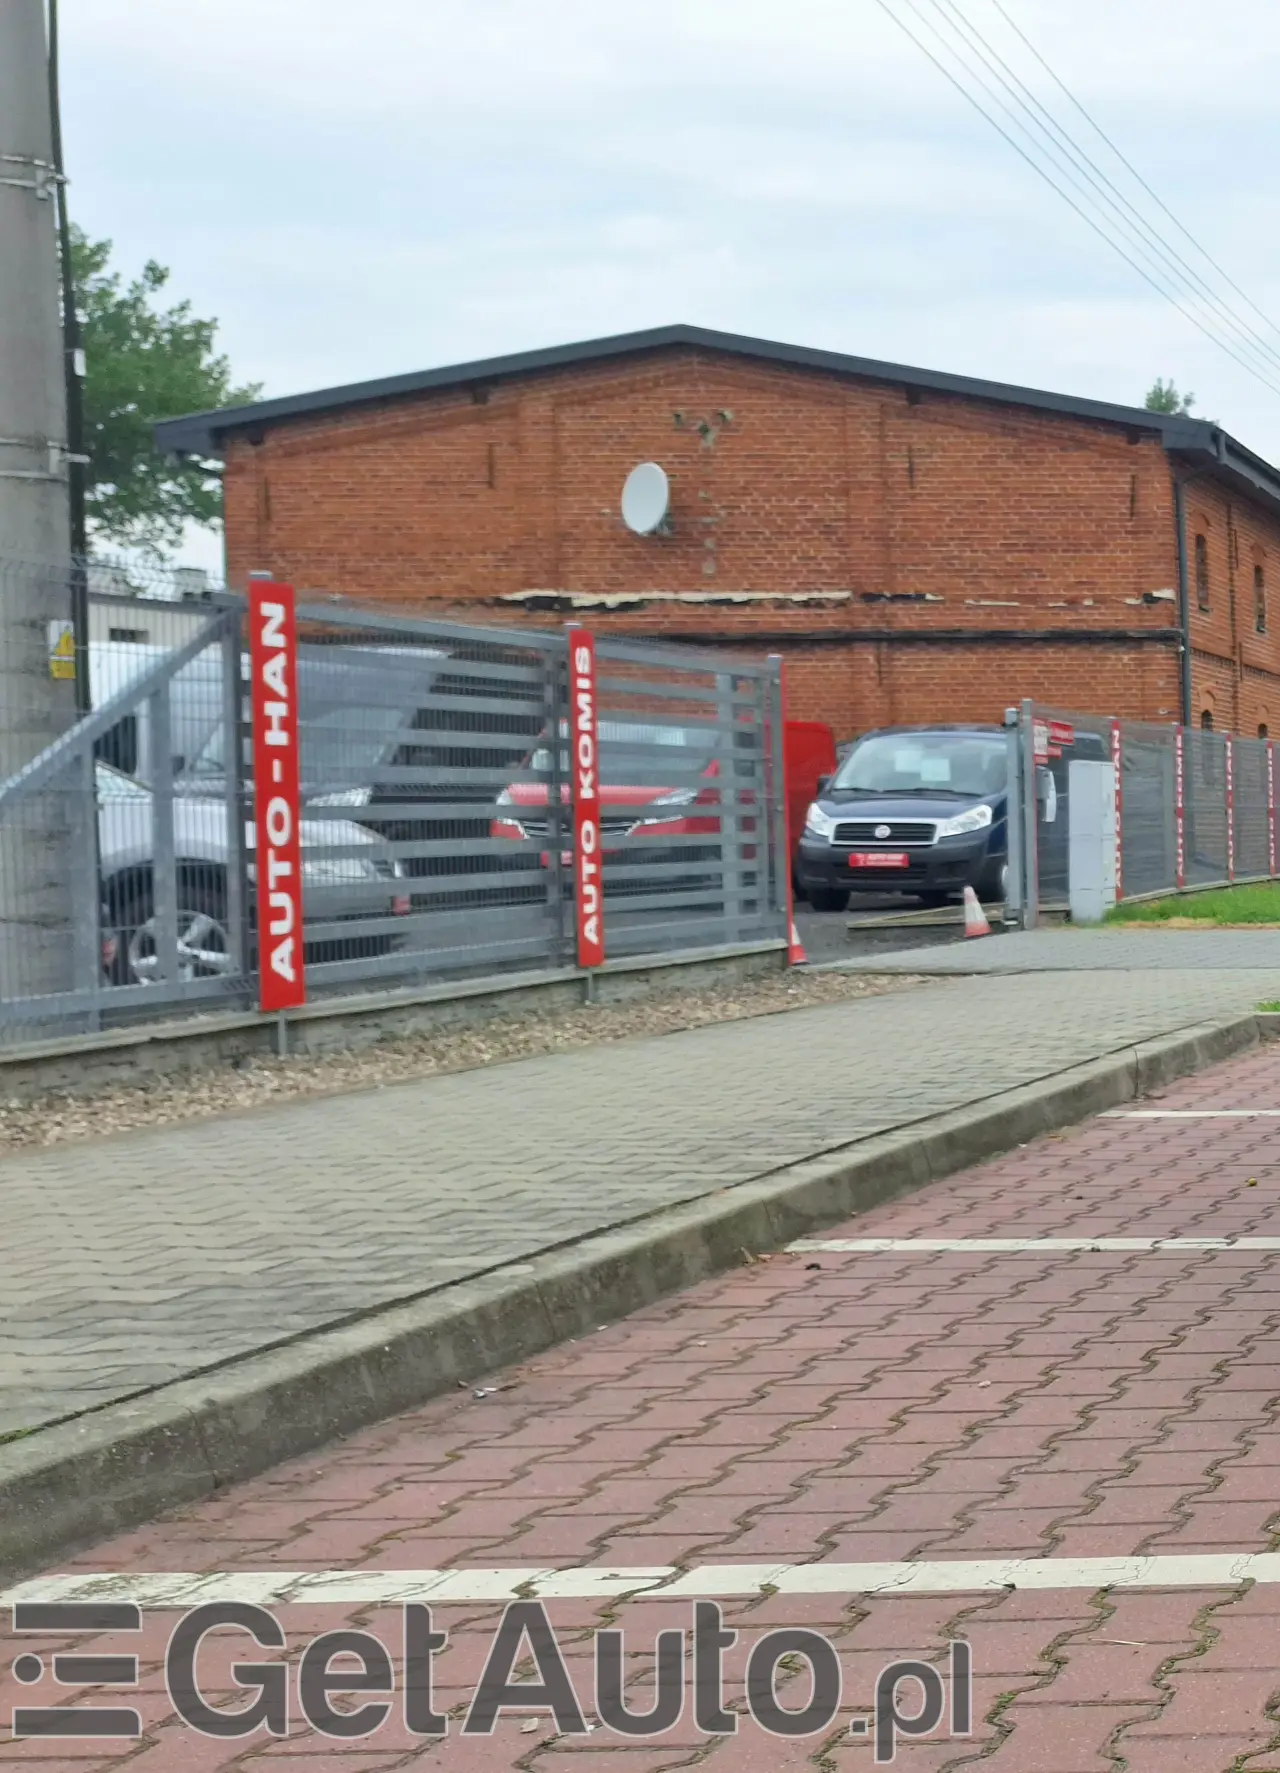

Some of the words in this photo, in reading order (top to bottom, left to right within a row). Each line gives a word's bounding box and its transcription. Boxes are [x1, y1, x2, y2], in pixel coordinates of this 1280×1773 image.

[260, 601, 289, 746] HAN
[574, 646, 595, 799] KOMIS
[266, 797, 296, 982] AUTO
[580, 819, 600, 945] AUTO
